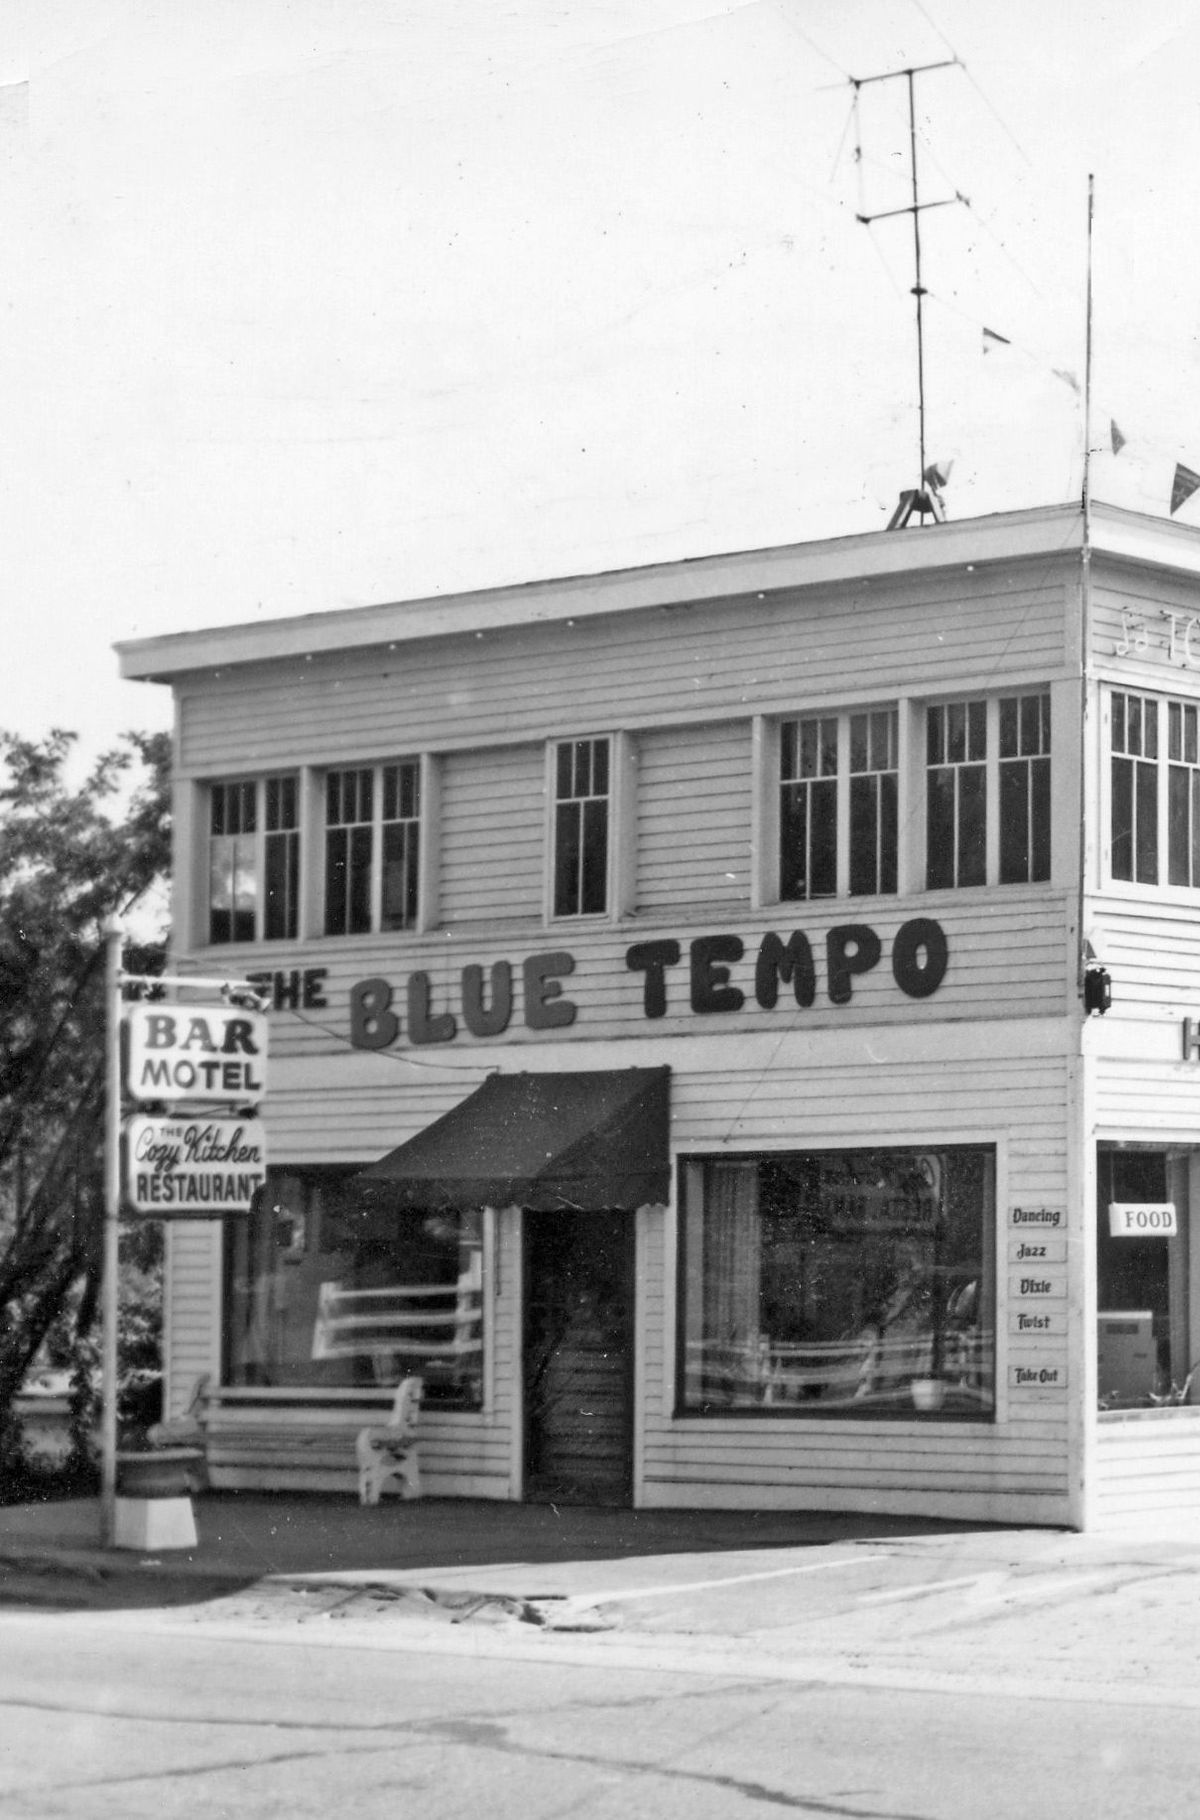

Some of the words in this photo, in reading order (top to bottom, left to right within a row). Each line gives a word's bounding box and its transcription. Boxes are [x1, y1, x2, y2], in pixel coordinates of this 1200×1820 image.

[349, 951, 577, 1050] BLUE
[625, 917, 948, 1019] TEMPO
[144, 1014, 259, 1056] BAR
[140, 1058, 262, 1091] MOTEL
[159, 1127, 183, 1138] THE
[134, 1125, 181, 1172] Cozy
[183, 1124, 262, 1164] Kitchen
[136, 1172, 263, 1203] RESTAURANT
[1012, 1207, 1061, 1227] Dancing
[1124, 1210, 1173, 1228] FOOD
[1016, 1243, 1047, 1260] Jazz
[1020, 1278, 1052, 1294] Dixie
[1017, 1313, 1050, 1331] Twist
[1014, 1367, 1037, 1383] Take
[1039, 1368, 1059, 1383] Out
